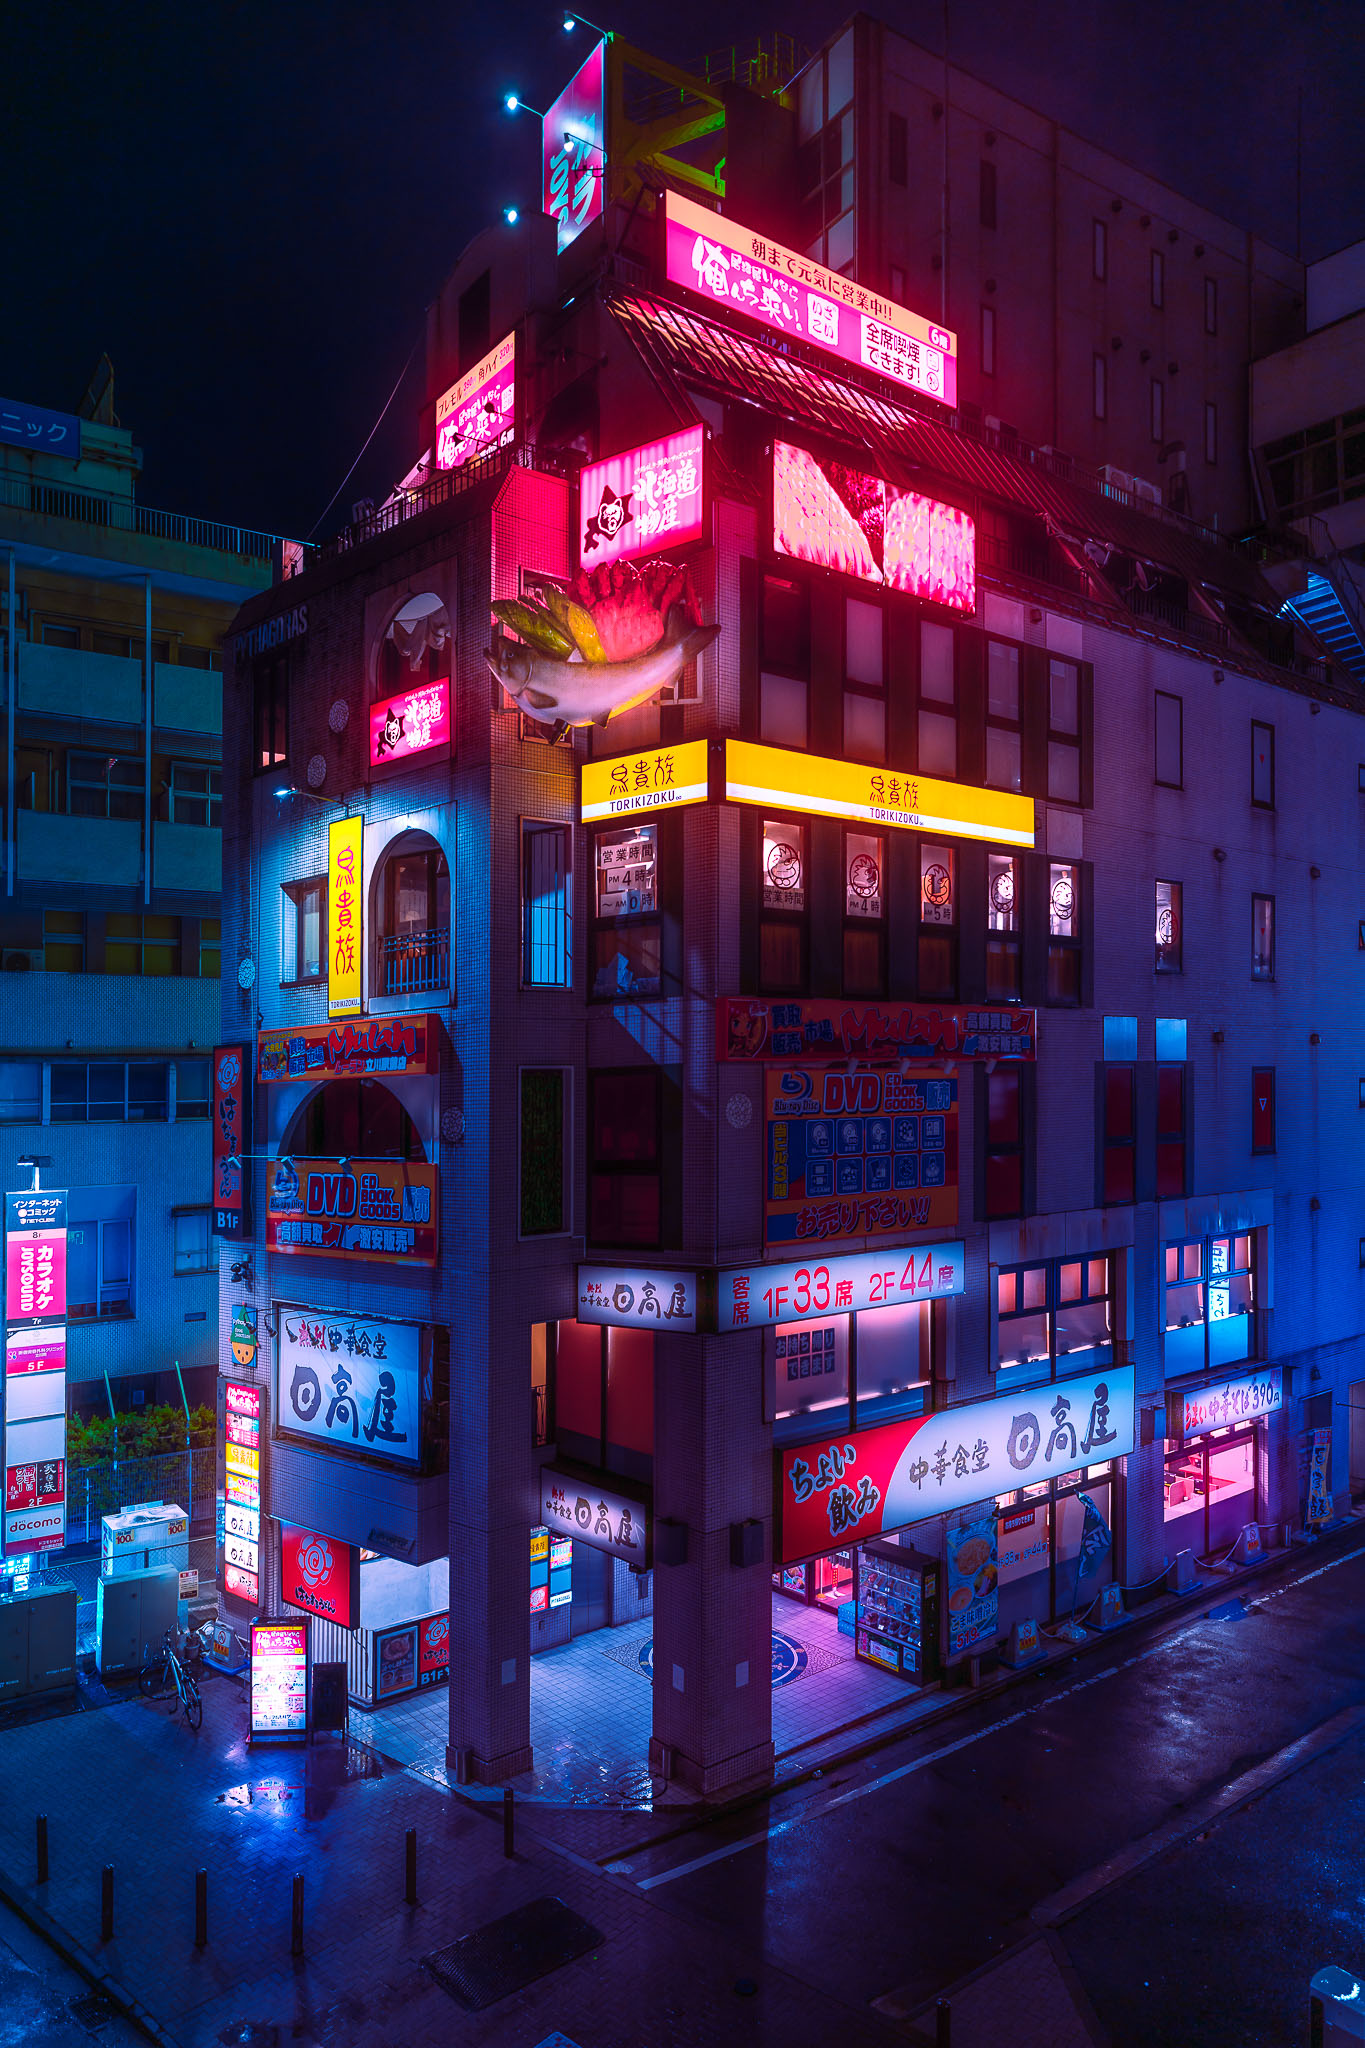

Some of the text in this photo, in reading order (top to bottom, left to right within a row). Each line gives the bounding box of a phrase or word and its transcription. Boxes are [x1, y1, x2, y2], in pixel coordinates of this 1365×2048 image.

[866, 322, 921, 364] 全席喫煙
[0, 412, 67, 442] ニック
[631, 458, 702, 510] 北海道
[634, 494, 681, 536] 物産
[404, 692, 444, 729] 北海道
[406, 718, 433, 748] 物産
[609, 754, 675, 796] 鳥貴族
[610, 790, 675, 812] TORIKIZOKU
[869, 775, 919, 809] 鳥貴族
[870, 807, 919, 826] TORIKIZOKU
[602, 843, 653, 864] 営業時間
[763, 889, 804, 905] 営業時間
[825, 1074, 880, 1113] DVD
[885, 1085, 917, 1098] BOOK
[886, 1073, 902, 1086] CD
[884, 1097, 924, 1112] GOODS
[308, 1174, 356, 1214] DVD
[361, 1174, 378, 1189] CD
[361, 1189, 394, 1203] BOOK
[12, 1198, 63, 1209] インターネット
[360, 1203, 400, 1219] GOODS
[796, 1196, 930, 1238] お売り下さい!!
[217, 1211, 239, 1228] B1F
[281, 1222, 323, 1244] 高額買取
[360, 1227, 409, 1252] 激安販売
[20, 1246, 34, 1312] JOYSOUND
[36, 1244, 54, 1310] カラオケ
[613, 1281, 692, 1319] 日高屋
[732, 1275, 751, 1325] 客席
[776, 1331, 834, 1357] お持ち帰り
[788, 1355, 834, 1378] できます
[290, 1364, 407, 1443] 日高屋
[1185, 1401, 1207, 1431] うまい
[1208, 1383, 1252, 1422] 中華そば
[1006, 1382, 1117, 1472] 日高屋
[789, 1444, 856, 1504] ちょい
[909, 1440, 990, 1490] 中華食堂
[829, 1476, 880, 1537] 飲み
[9, 1517, 61, 1533] docomo
[574, 1496, 637, 1548] 日高屋
[295, 1585, 336, 1613] はなまるうどん
[421, 1668, 444, 1685] B1F
